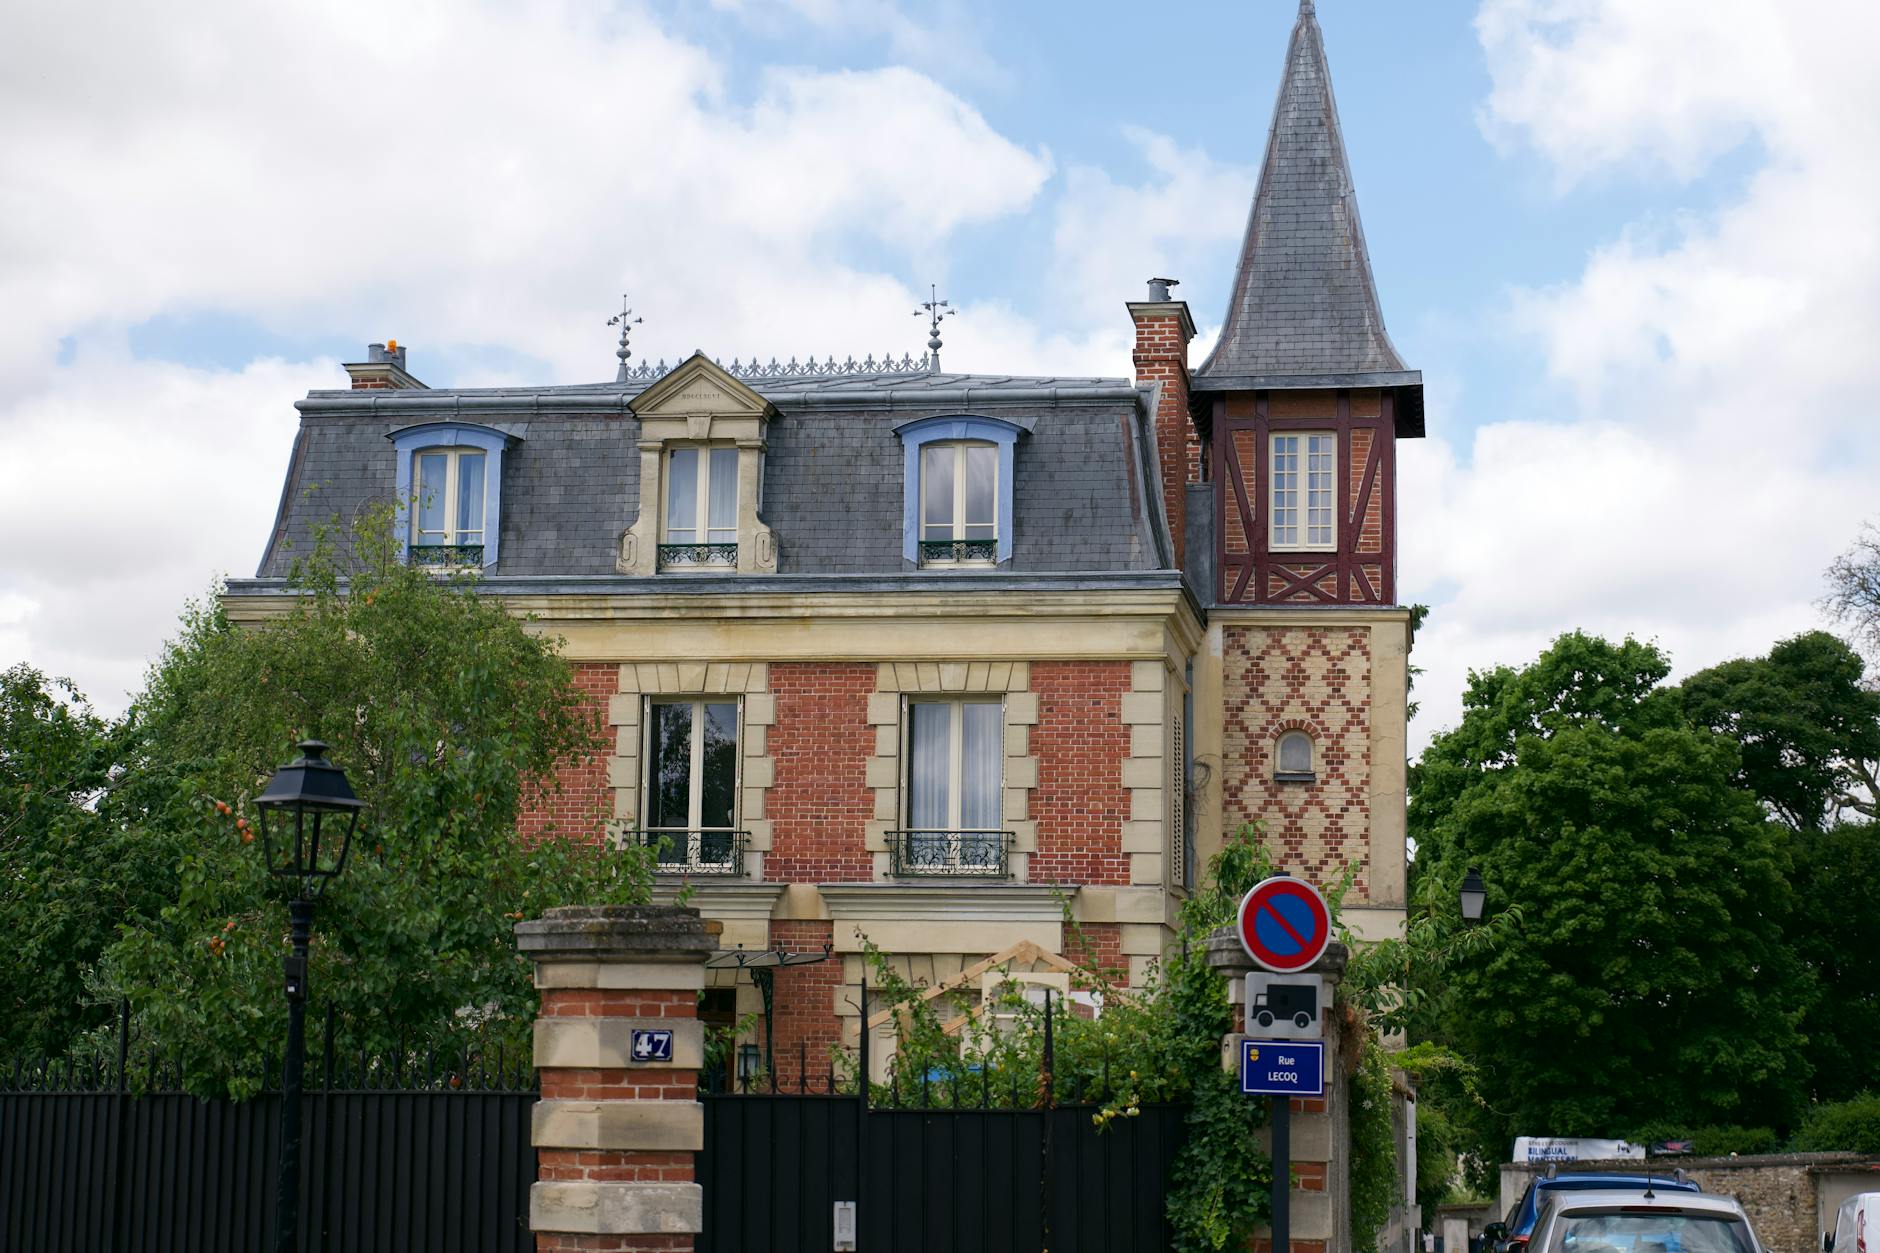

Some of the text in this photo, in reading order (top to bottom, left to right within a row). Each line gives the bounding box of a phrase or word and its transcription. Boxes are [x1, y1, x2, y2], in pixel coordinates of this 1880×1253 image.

[635, 1033, 669, 1057] 47
[1278, 1055, 1295, 1066] Rue
[1268, 1071, 1298, 1084] LECOQ
[1527, 1146, 1568, 1156] BILINGUAL
